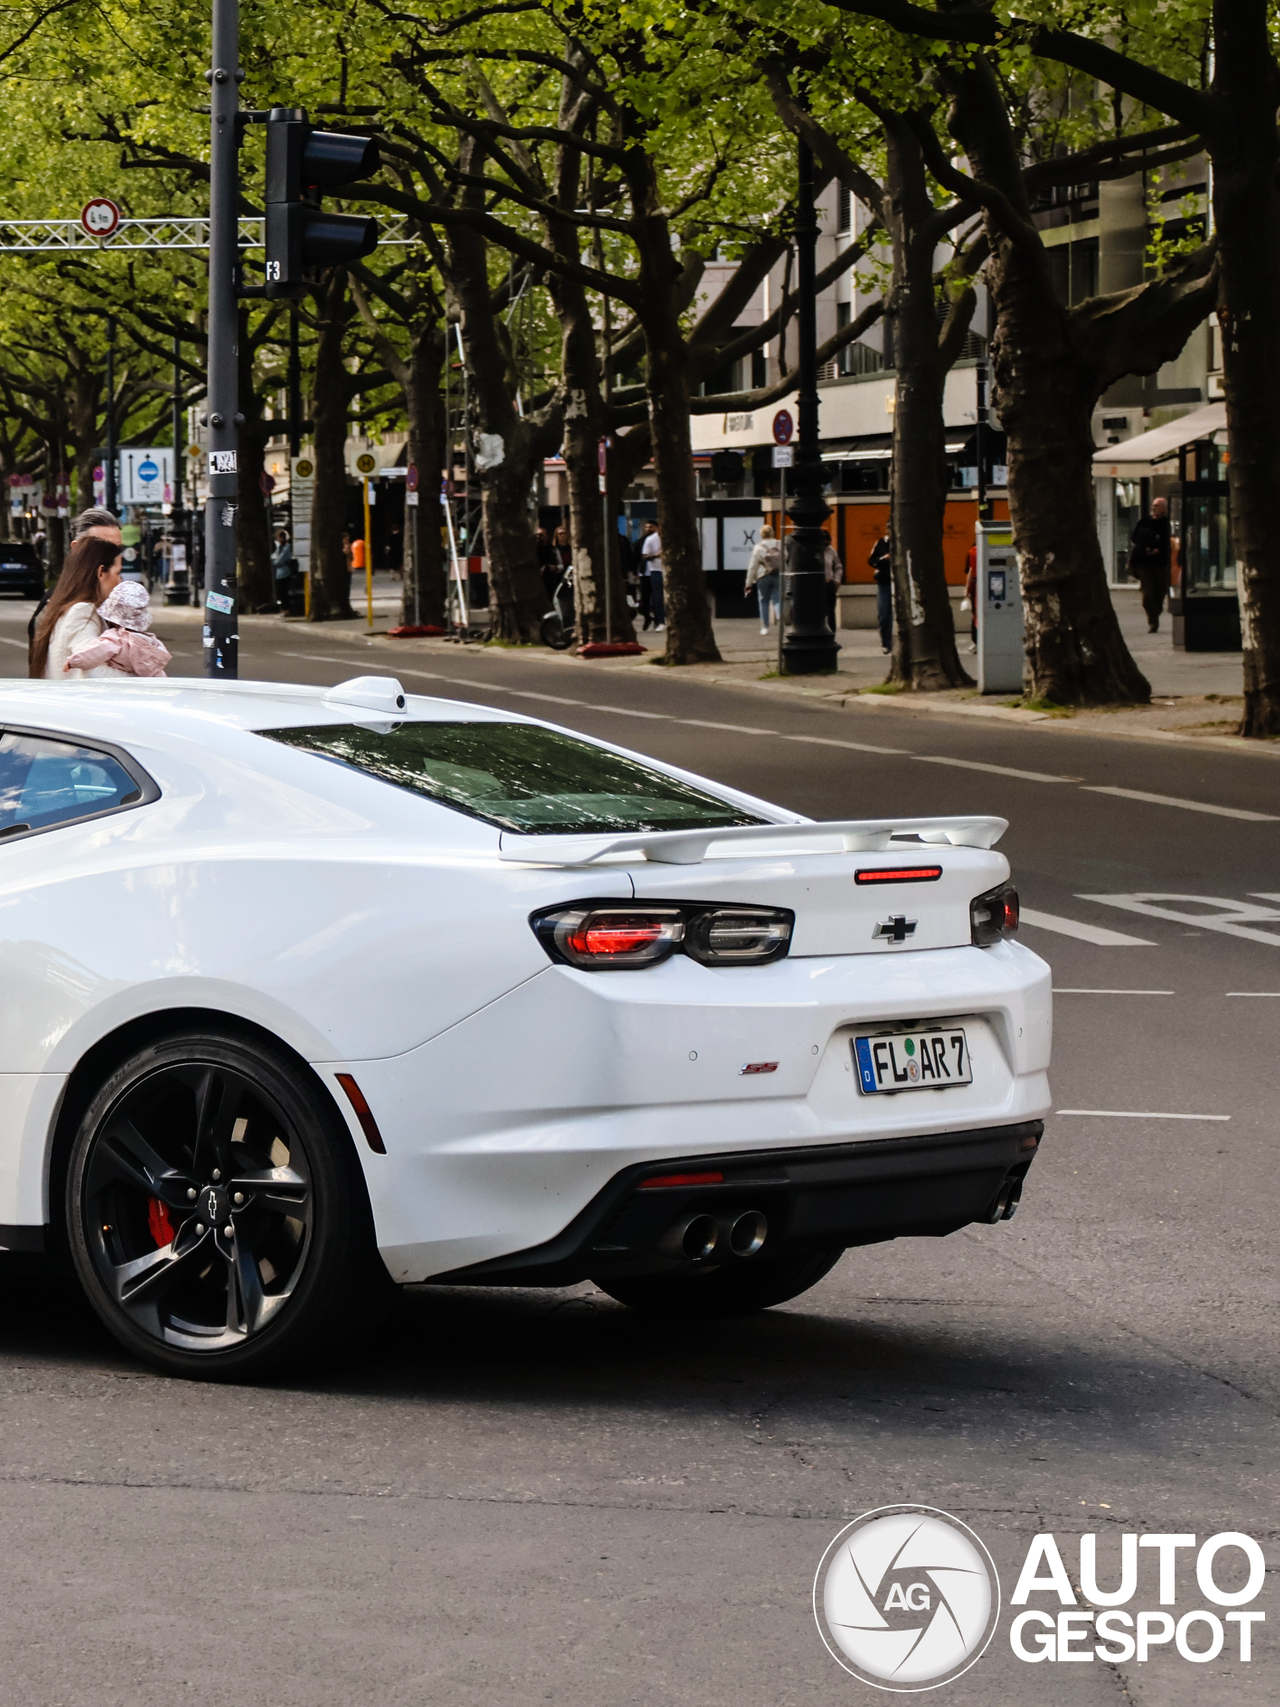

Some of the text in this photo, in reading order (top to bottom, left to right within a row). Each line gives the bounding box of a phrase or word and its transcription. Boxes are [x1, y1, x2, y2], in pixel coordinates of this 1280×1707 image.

[266, 260, 281, 281] F3
[873, 1036, 964, 1084] FL AR 7
